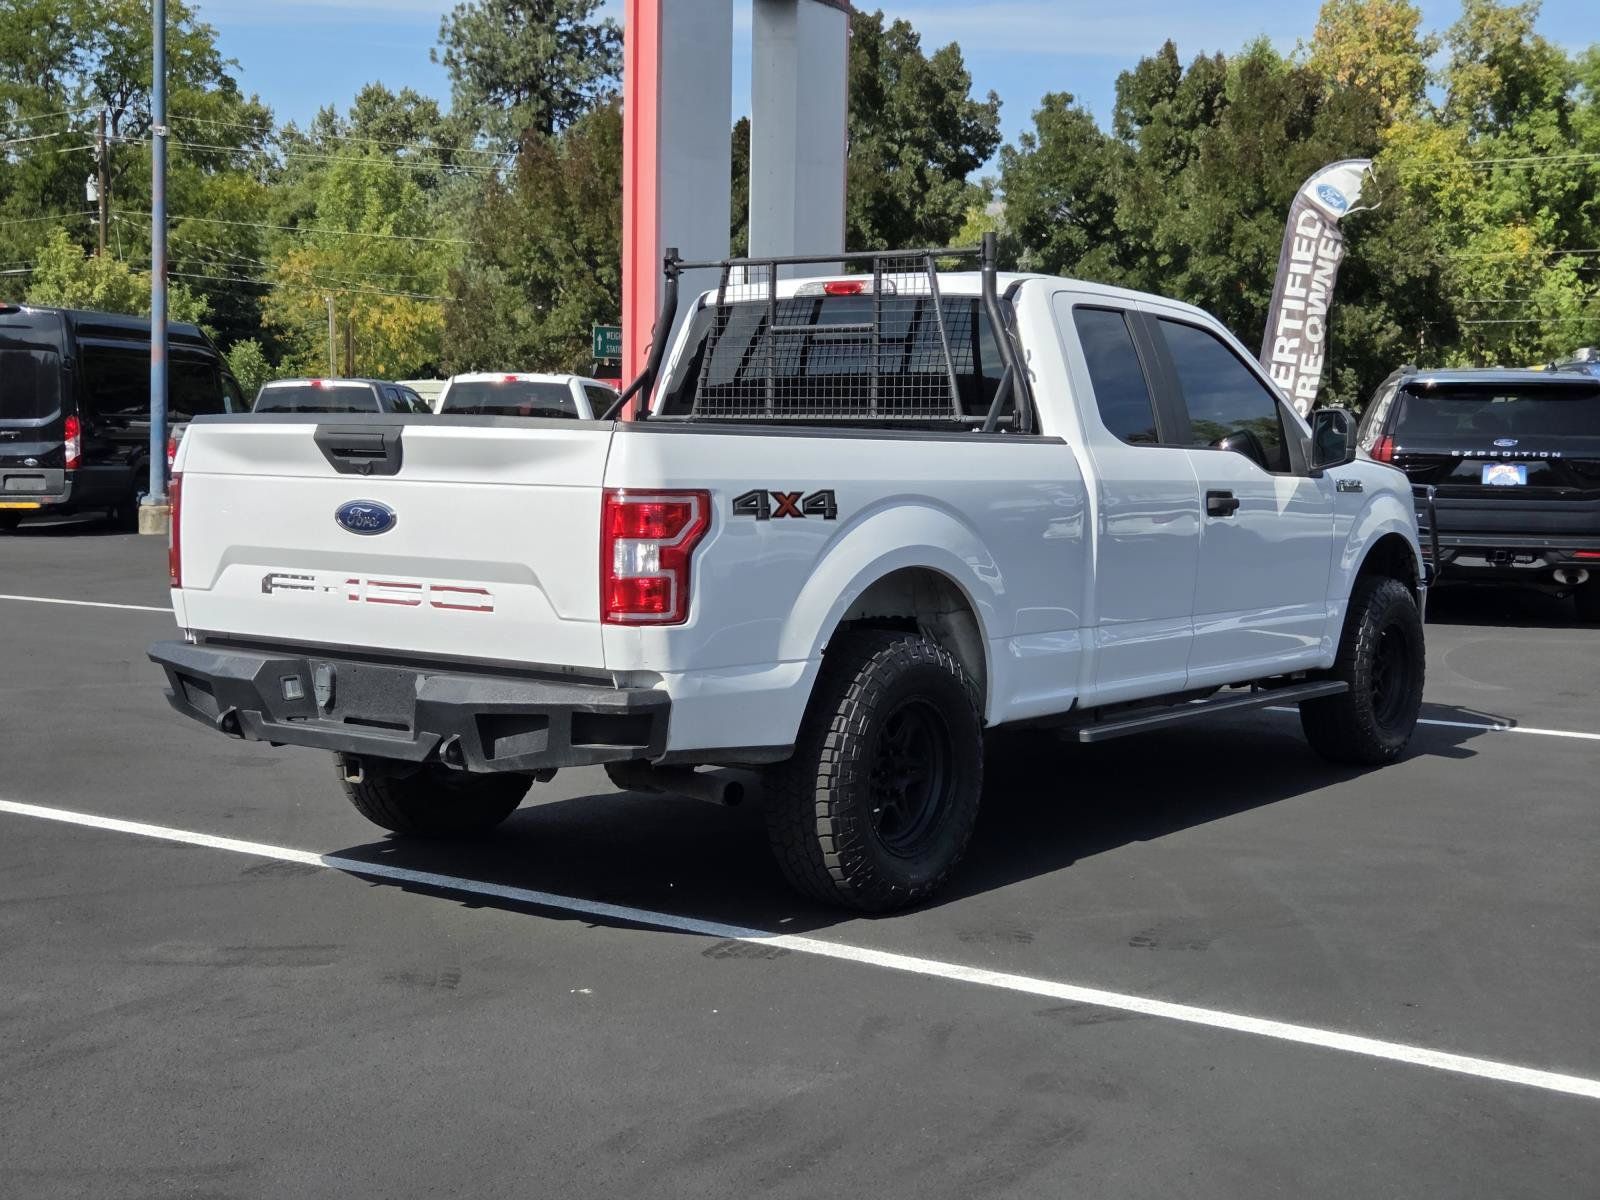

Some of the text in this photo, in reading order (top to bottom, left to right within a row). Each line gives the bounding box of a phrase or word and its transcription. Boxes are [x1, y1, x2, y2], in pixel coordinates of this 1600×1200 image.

[1270, 208, 1322, 400] ERTIFIED
[1451, 450, 1562, 458] EXPEDITION
[261, 572, 495, 612] F-150
